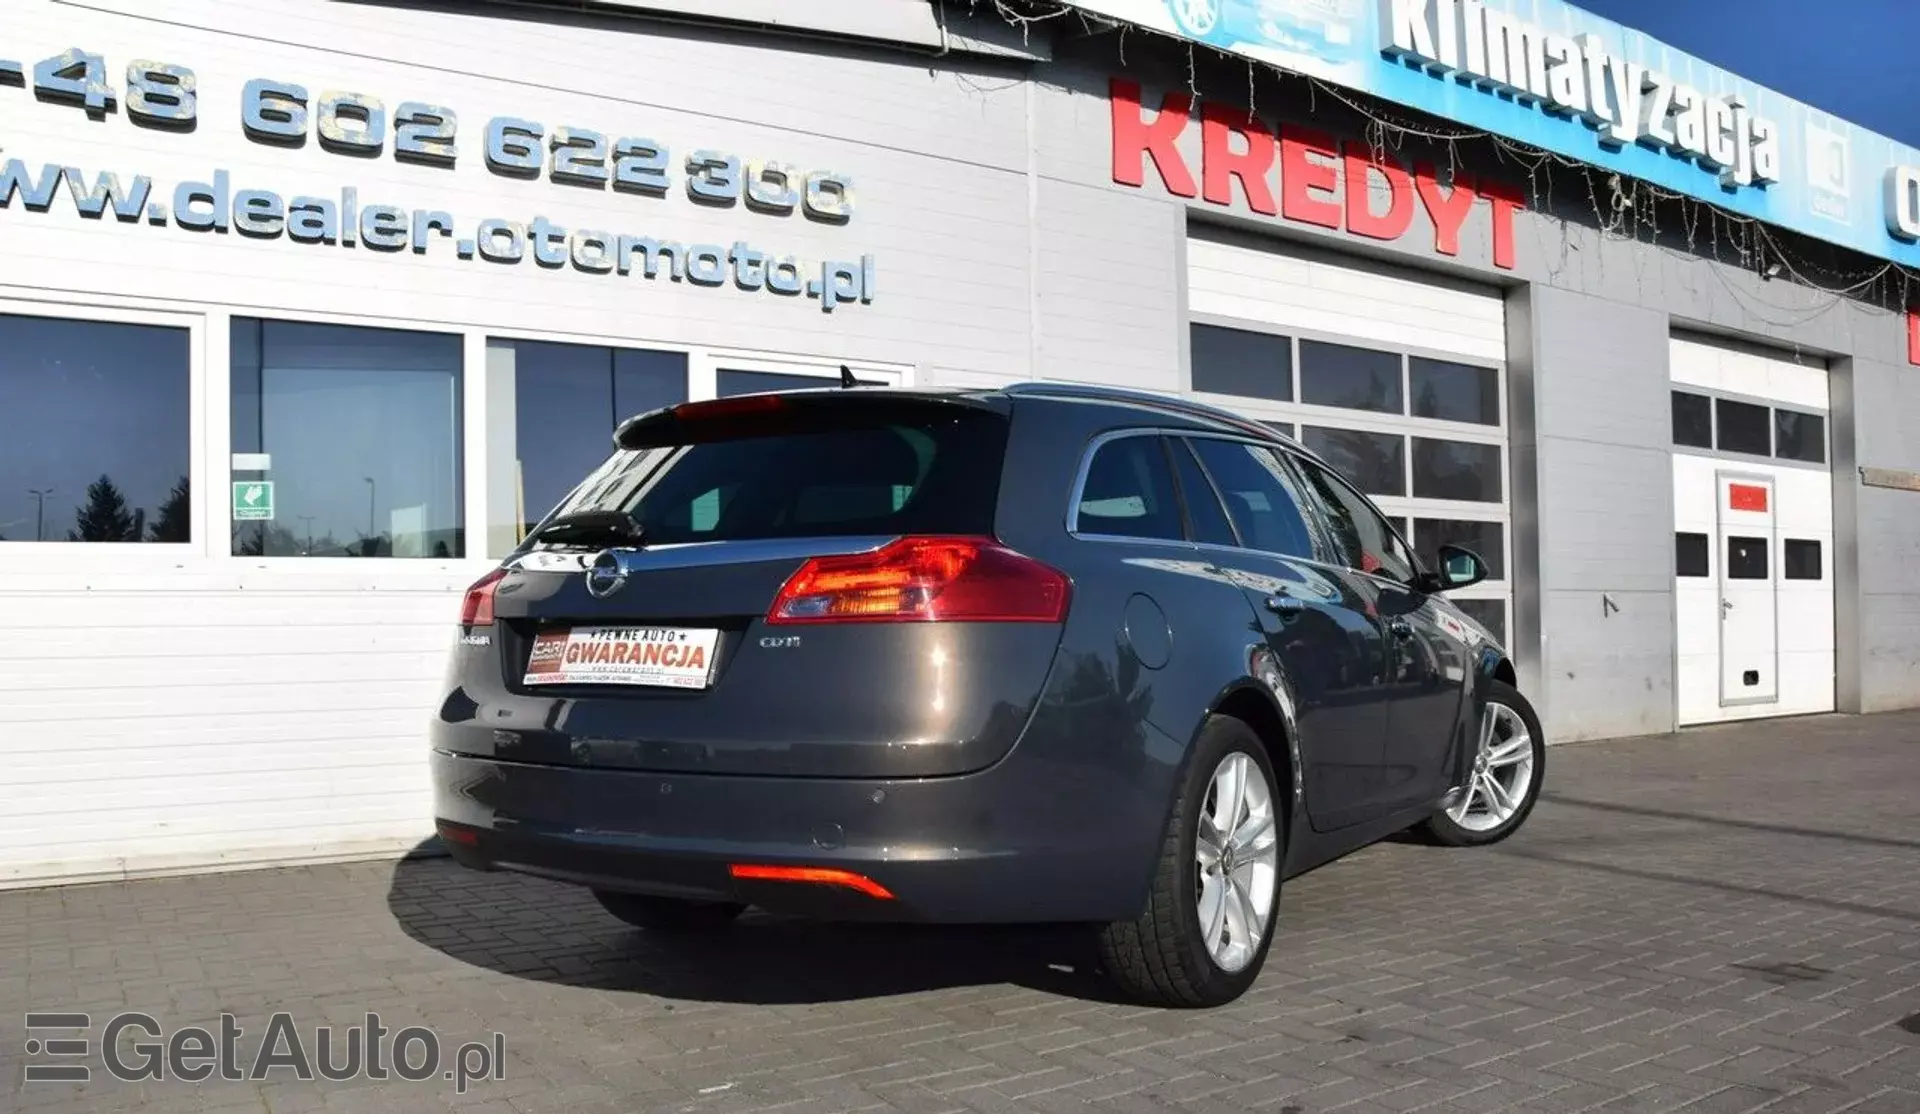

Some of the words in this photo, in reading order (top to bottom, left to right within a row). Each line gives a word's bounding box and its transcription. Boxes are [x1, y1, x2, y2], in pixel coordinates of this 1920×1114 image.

[241, 78, 458, 167] 602
[484, 116, 670, 200] 622
[685, 149, 855, 227] 300
[1109, 77, 1526, 271] KREDYT
[565, 641, 705, 669] GWARANCJA
[598, 628, 639, 642] PEWNE
[643, 629, 676, 642] AUTO
